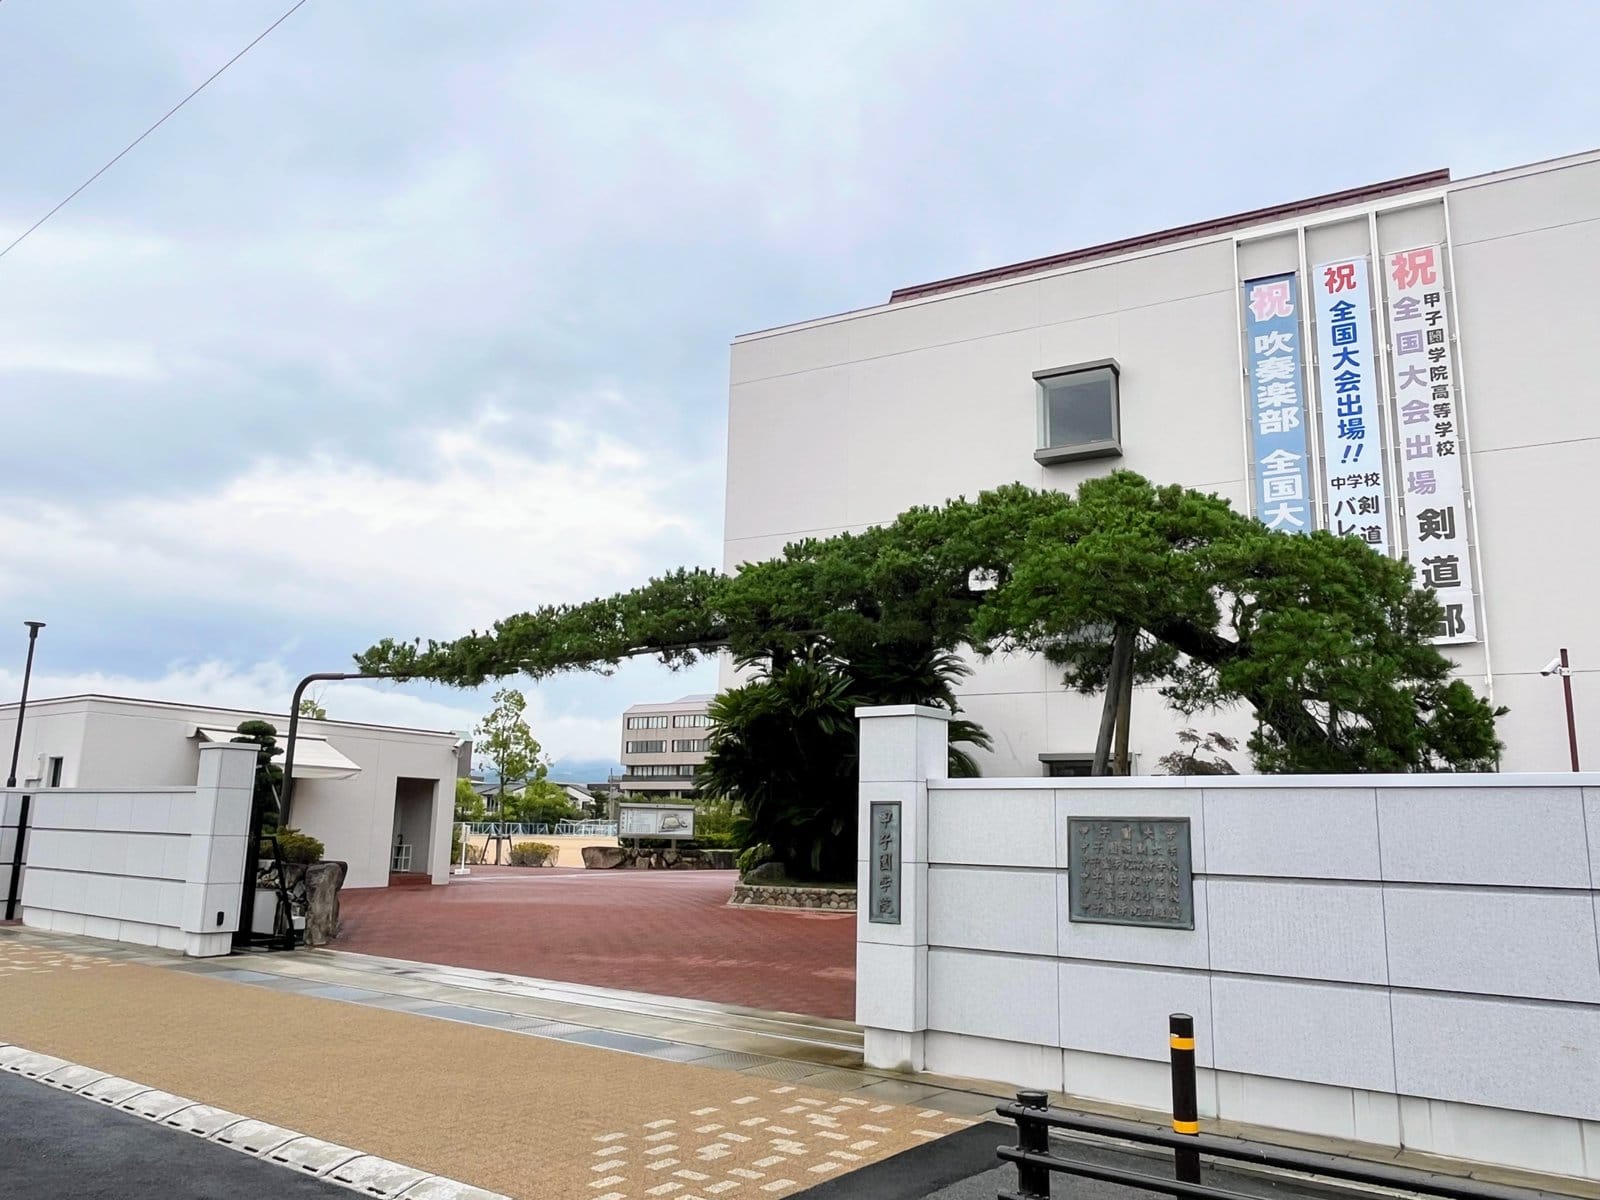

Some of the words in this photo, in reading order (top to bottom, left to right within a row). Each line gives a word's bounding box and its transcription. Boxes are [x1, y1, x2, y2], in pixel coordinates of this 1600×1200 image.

[1249, 280, 1294, 322] 祝
[1324, 264, 1357, 294] 祝
[1391, 248, 1437, 290] 祝
[1254, 331, 1300, 435] 吹奏楽部
[1393, 296, 1437, 495] 全国大会出場
[1424, 292, 1455, 456] 甲子園学院高等学校
[1260, 449, 1304, 536] 全国大
[1331, 472, 1381, 490] 中学校
